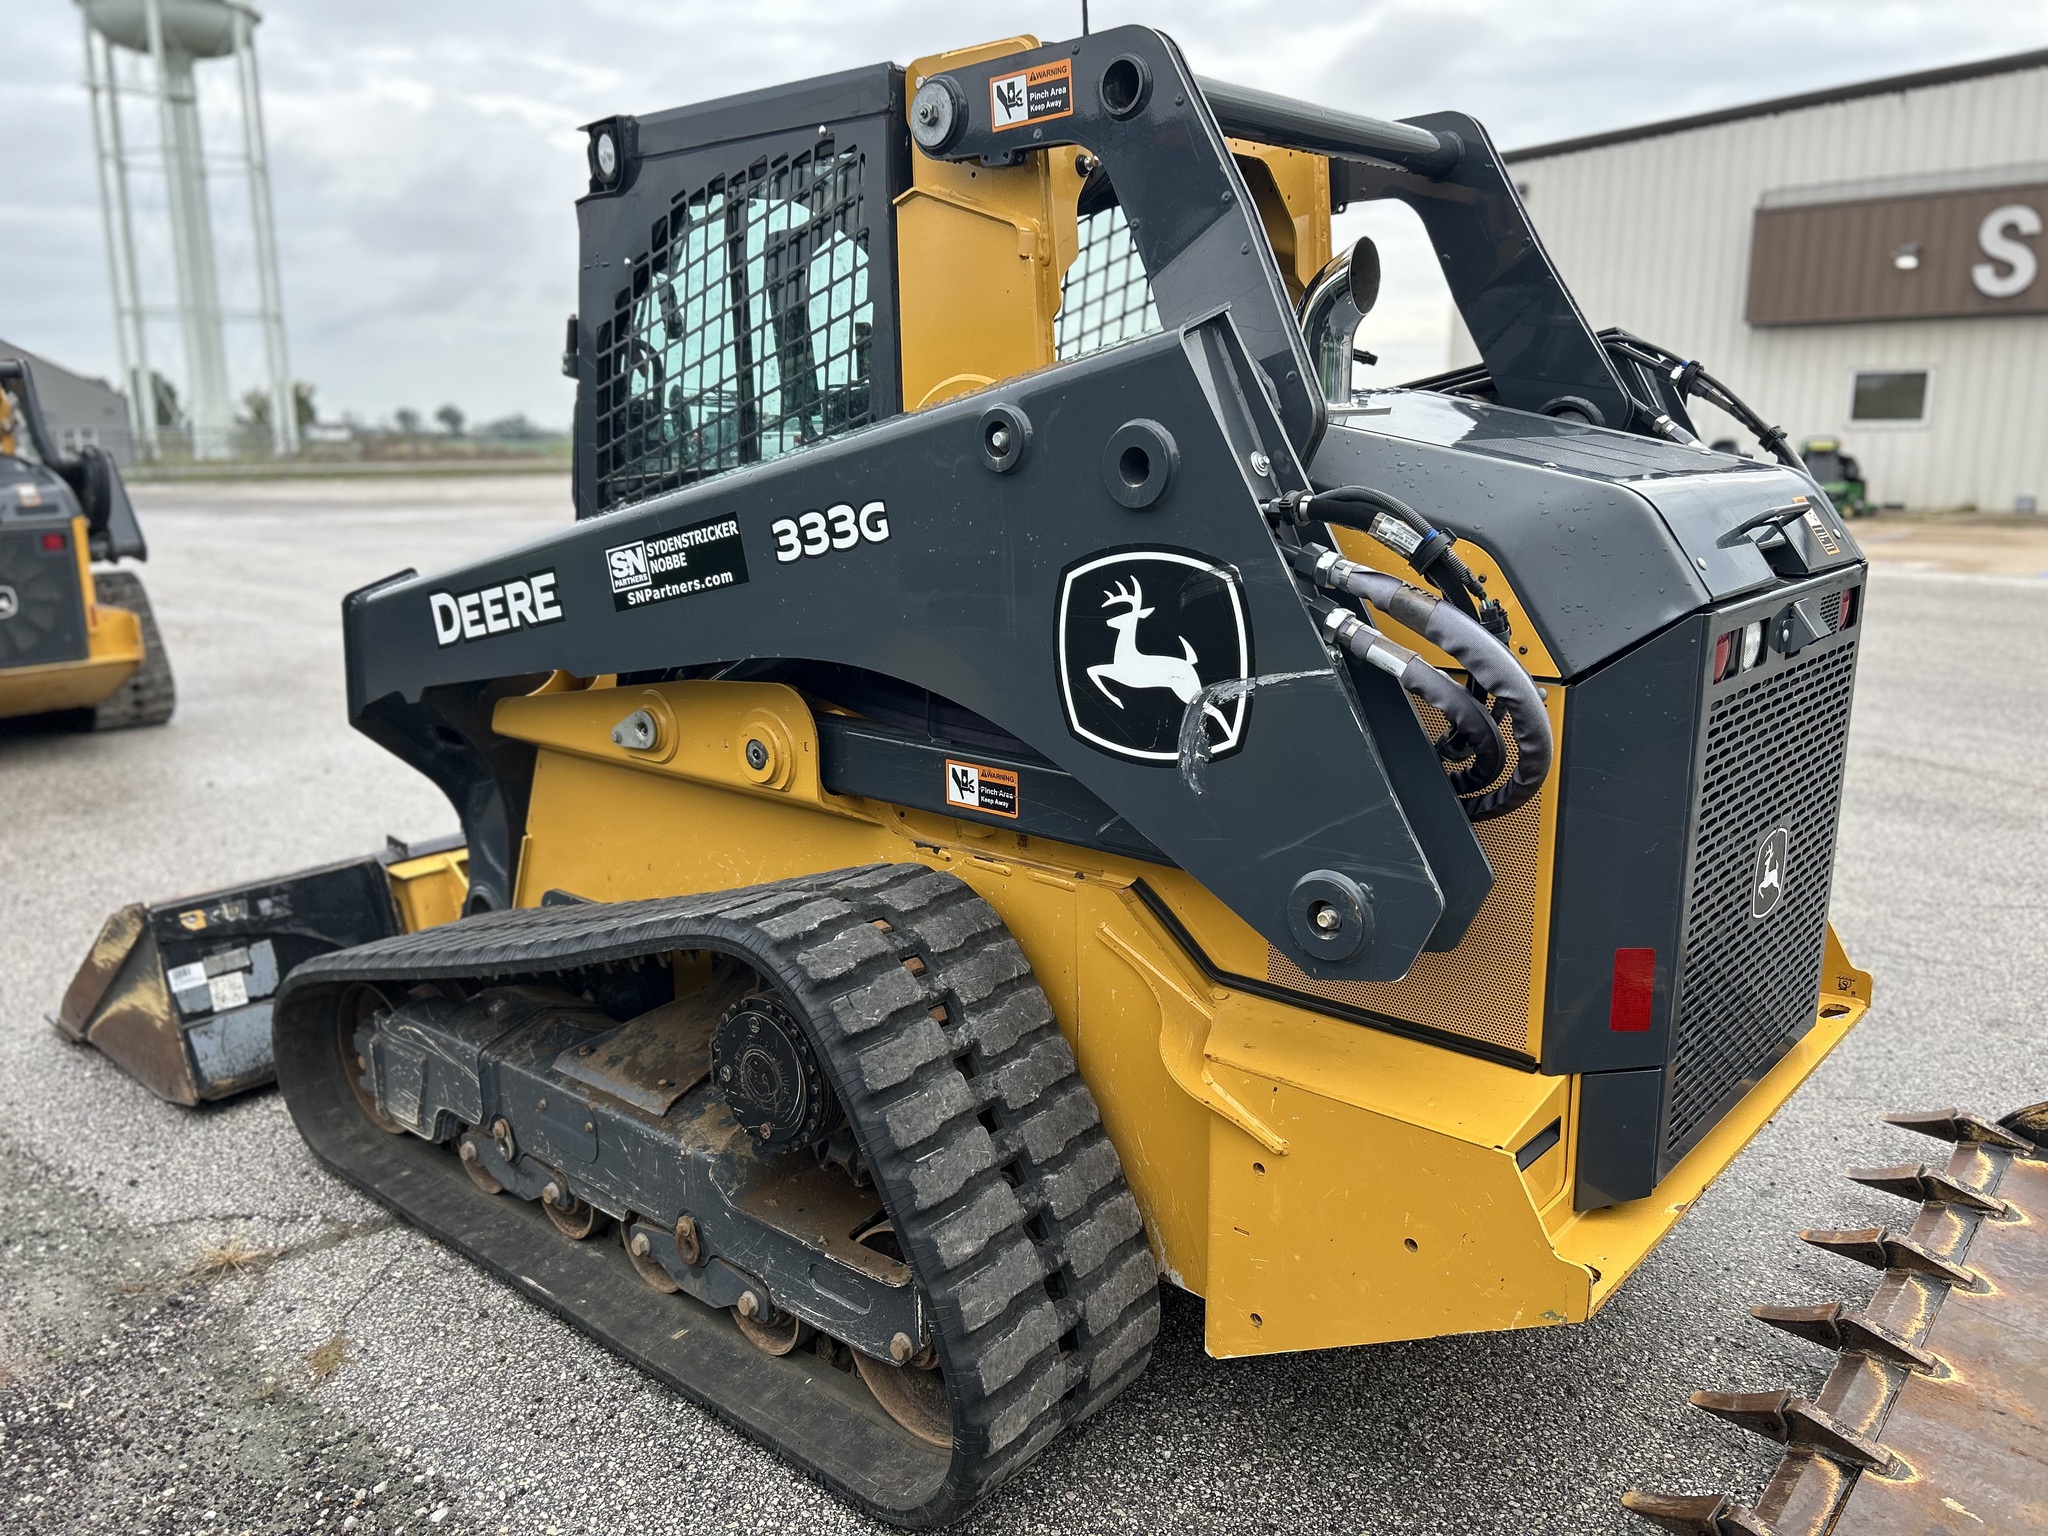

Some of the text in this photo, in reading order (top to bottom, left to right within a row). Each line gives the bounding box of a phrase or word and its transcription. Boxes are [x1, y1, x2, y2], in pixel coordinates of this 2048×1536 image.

[1036, 65, 1067, 80] WARNING
[1030, 86, 1067, 102] Pinch Area
[1030, 103, 1046, 112] Keep
[1046, 99, 1062, 109] Away
[646, 520, 740, 558] SYDENSTRICKER
[771, 501, 890, 562] 333G
[649, 551, 688, 575] NOBBE
[614, 573, 649, 588] PARTNERS
[627, 570, 734, 605] SNPartners.com
[429, 572, 562, 645] DEERE
[986, 771, 1015, 783] WARNING
[980, 786, 1014, 799] Pinch Area
[980, 795, 1009, 808] Keep Away
